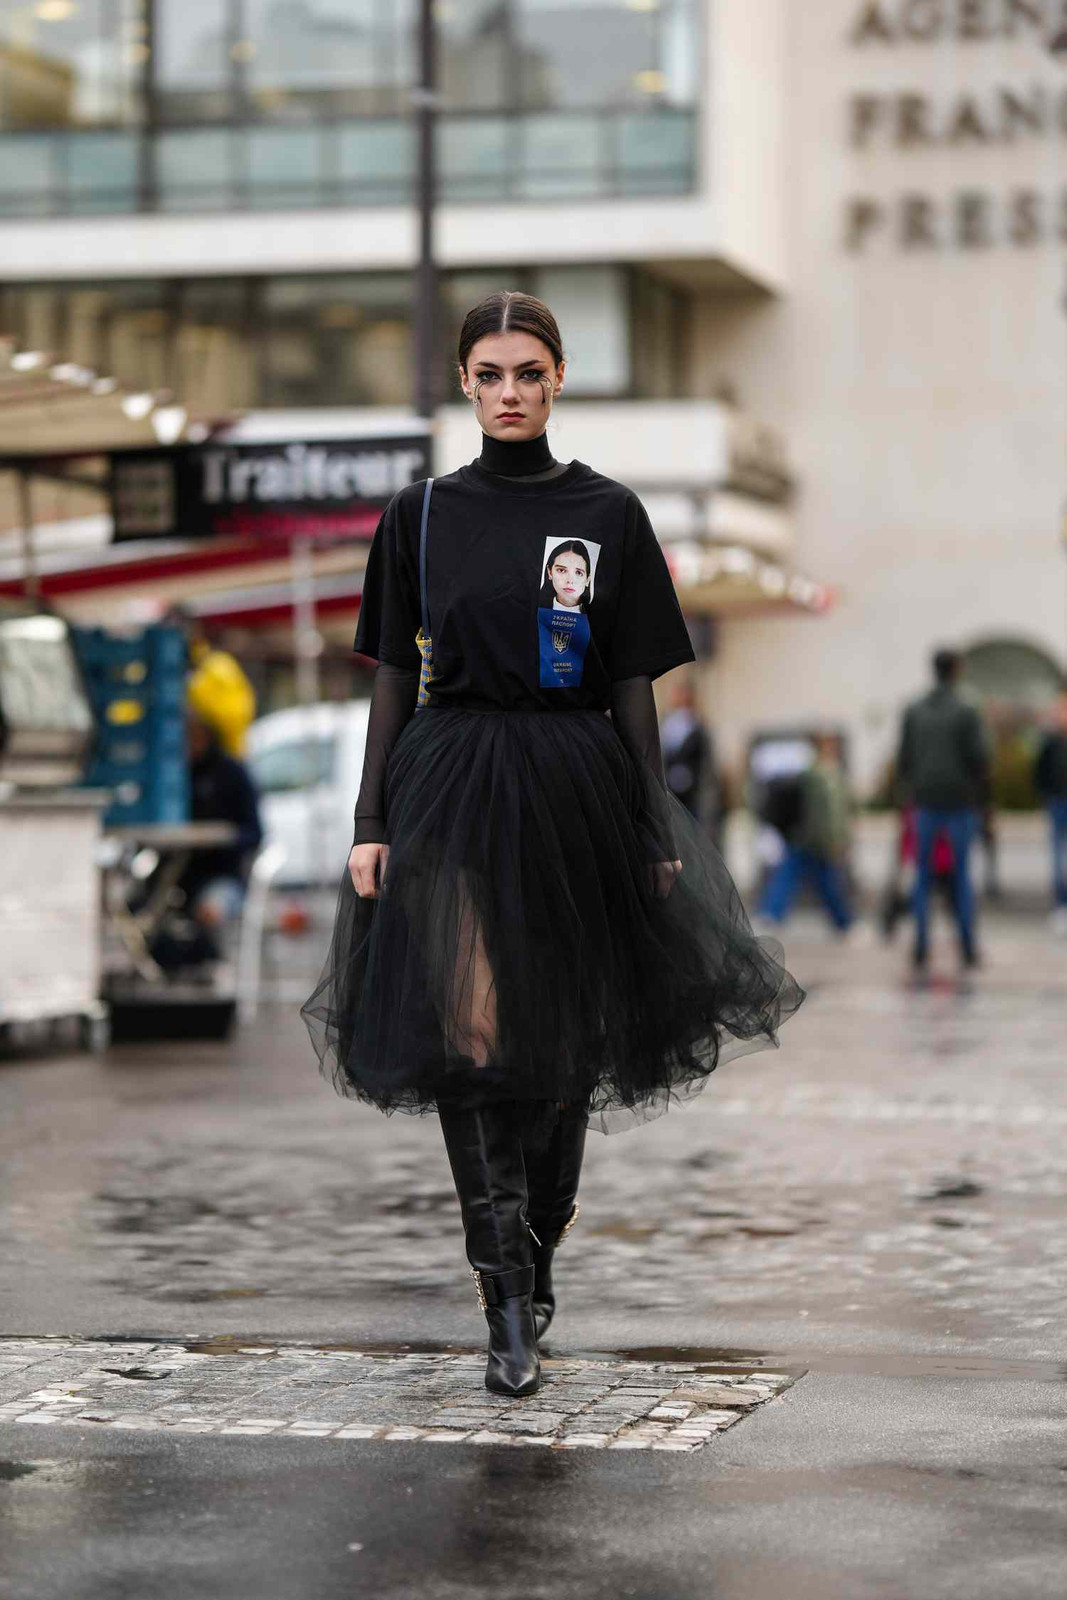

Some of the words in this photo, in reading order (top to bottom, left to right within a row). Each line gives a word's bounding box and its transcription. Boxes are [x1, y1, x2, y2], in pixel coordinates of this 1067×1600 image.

[846, 0, 1067, 46] AGEN
[850, 87, 1067, 150] FRAN
[846, 189, 1067, 252] PRES
